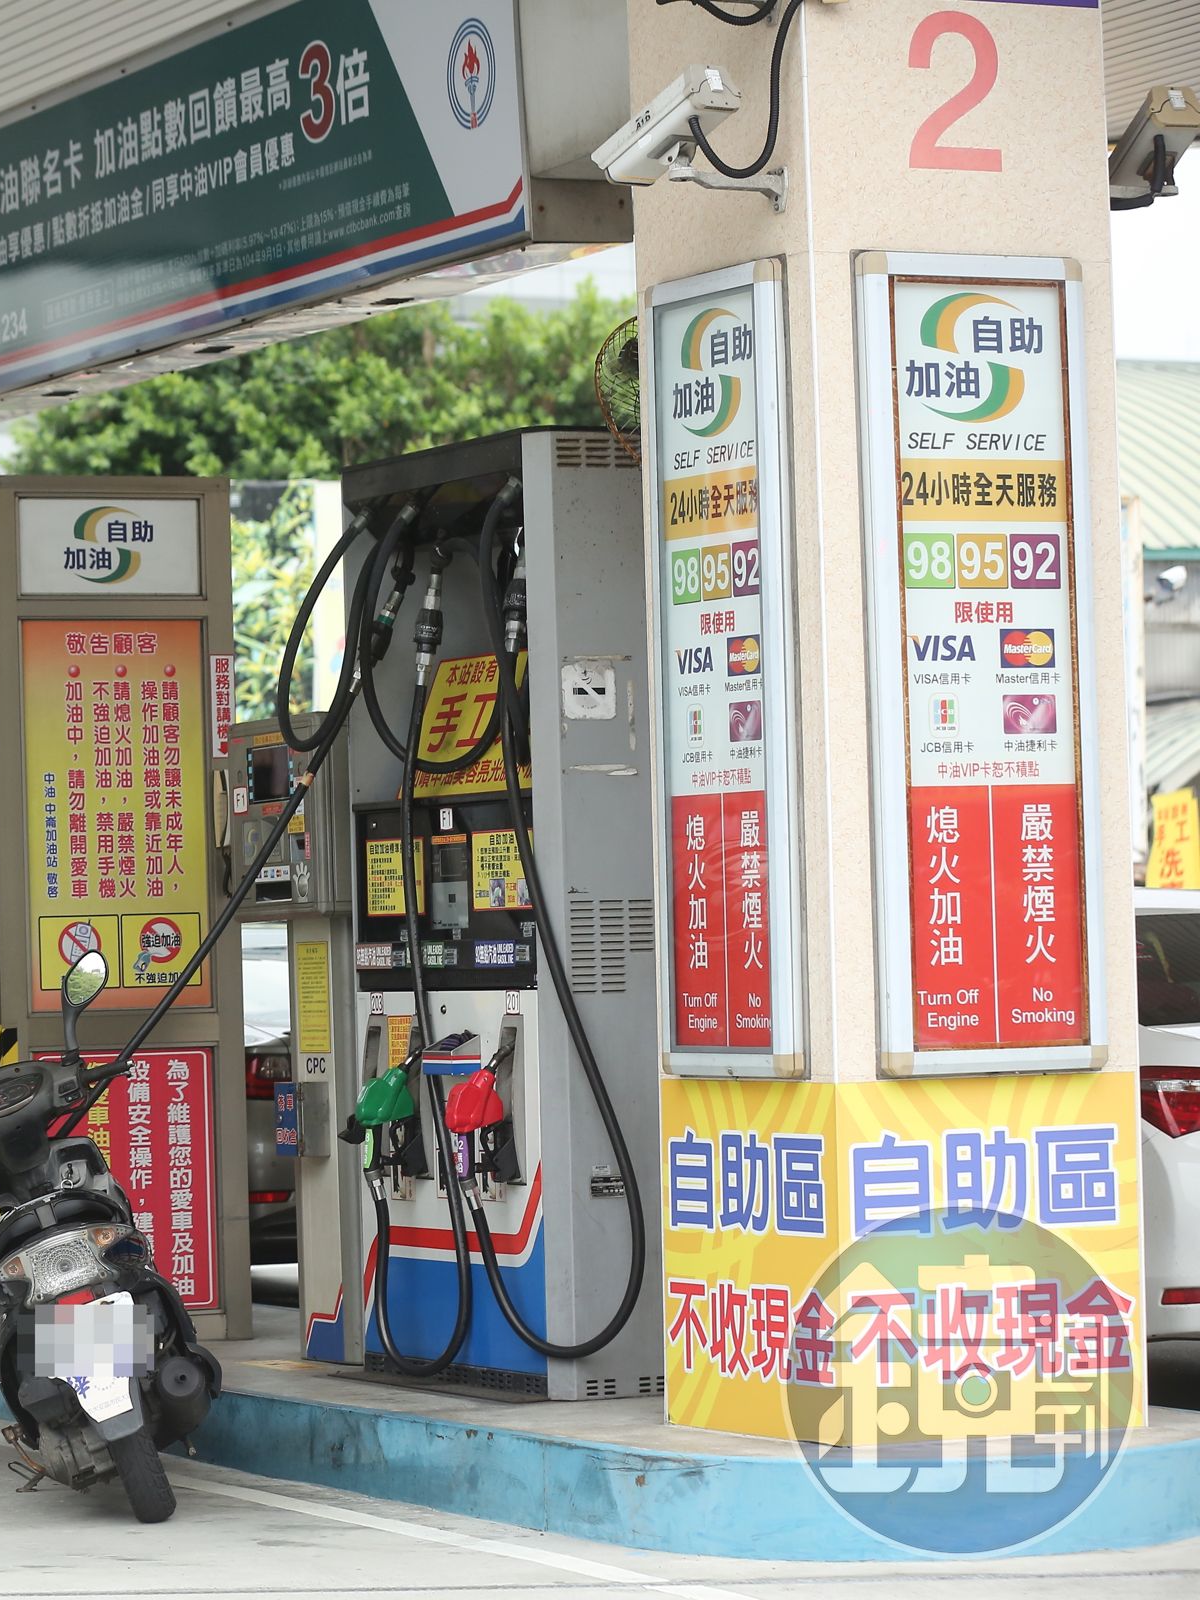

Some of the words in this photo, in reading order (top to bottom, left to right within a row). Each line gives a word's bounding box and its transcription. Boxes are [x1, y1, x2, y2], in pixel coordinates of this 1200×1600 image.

[908, 10, 1003, 172] 2
[709, 322, 754, 368] 自助
[972, 316, 1043, 354] 自助
[905, 359, 980, 399] 加油
[672, 377, 715, 420] 加油
[674, 448, 701, 471] SELF
[706, 439, 755, 466] SERVICE
[907, 432, 955, 450] SELF
[966, 433, 1046, 451] SERVICE
[901, 471, 1057, 508] 24小時全天服務
[107, 520, 154, 543] 自助
[63, 547, 112, 570] 加油
[907, 541, 952, 580] 98
[959, 541, 1005, 580] 95
[1012, 541, 1057, 580] 92
[673, 553, 699, 596] 98
[703, 551, 730, 592] 95
[700, 610, 736, 636] 限使用
[954, 601, 1014, 624] 限使用
[66, 633, 157, 655] 敬告顧客
[912, 635, 976, 661] VISA
[1003, 643, 1053, 654] MasterCard
[445, 658, 499, 688] 本站設有
[676, 646, 714, 675] VISA
[678, 683, 711, 697] VISA信用卡
[913, 672, 971, 685] VISA信用卡
[995, 672, 1062, 685] Master信用卡
[682, 750, 714, 764] JCB信用卡
[920, 741, 974, 754] JCB信用卡
[1004, 740, 1058, 752] 中油捷利卡
[937, 761, 1040, 779] 中油VIP卡恕不積點
[65, 681, 89, 899] 加油中，請勿離開愛車
[92, 681, 116, 899] 不強迫加油，禁用手機
[113, 681, 136, 898] 請熄火加油，嚴禁煙火
[141, 680, 164, 897] 操作加油機或靠近加油
[686, 814, 708, 970] 熄火加油
[740, 810, 763, 969] 嚴禁煙火
[926, 805, 964, 966] 熄火加油
[1020, 804, 1057, 965] 嚴禁煙火
[141, 933, 182, 948] 強迫加油
[135, 972, 185, 984] 不強迫加
[506, 993, 519, 1011] 201
[682, 992, 703, 1008] Turn
[704, 992, 718, 1008] Off
[748, 992, 762, 1008] No
[917, 990, 952, 1006] Turn
[956, 989, 980, 1005] Off
[1032, 987, 1053, 1002] No
[688, 1014, 718, 1032] Engine
[927, 1012, 980, 1031] Engine
[1011, 1008, 1076, 1026] Smoking
[306, 1057, 327, 1074] CPC
[166, 1059, 195, 1296] 為了維護您的愛車及加油
[668, 1129, 825, 1236] 自助區
[851, 1126, 1119, 1238] 自助區
[668, 1280, 837, 1385] 不收現金
[850, 1279, 1133, 1386] 不收現金
